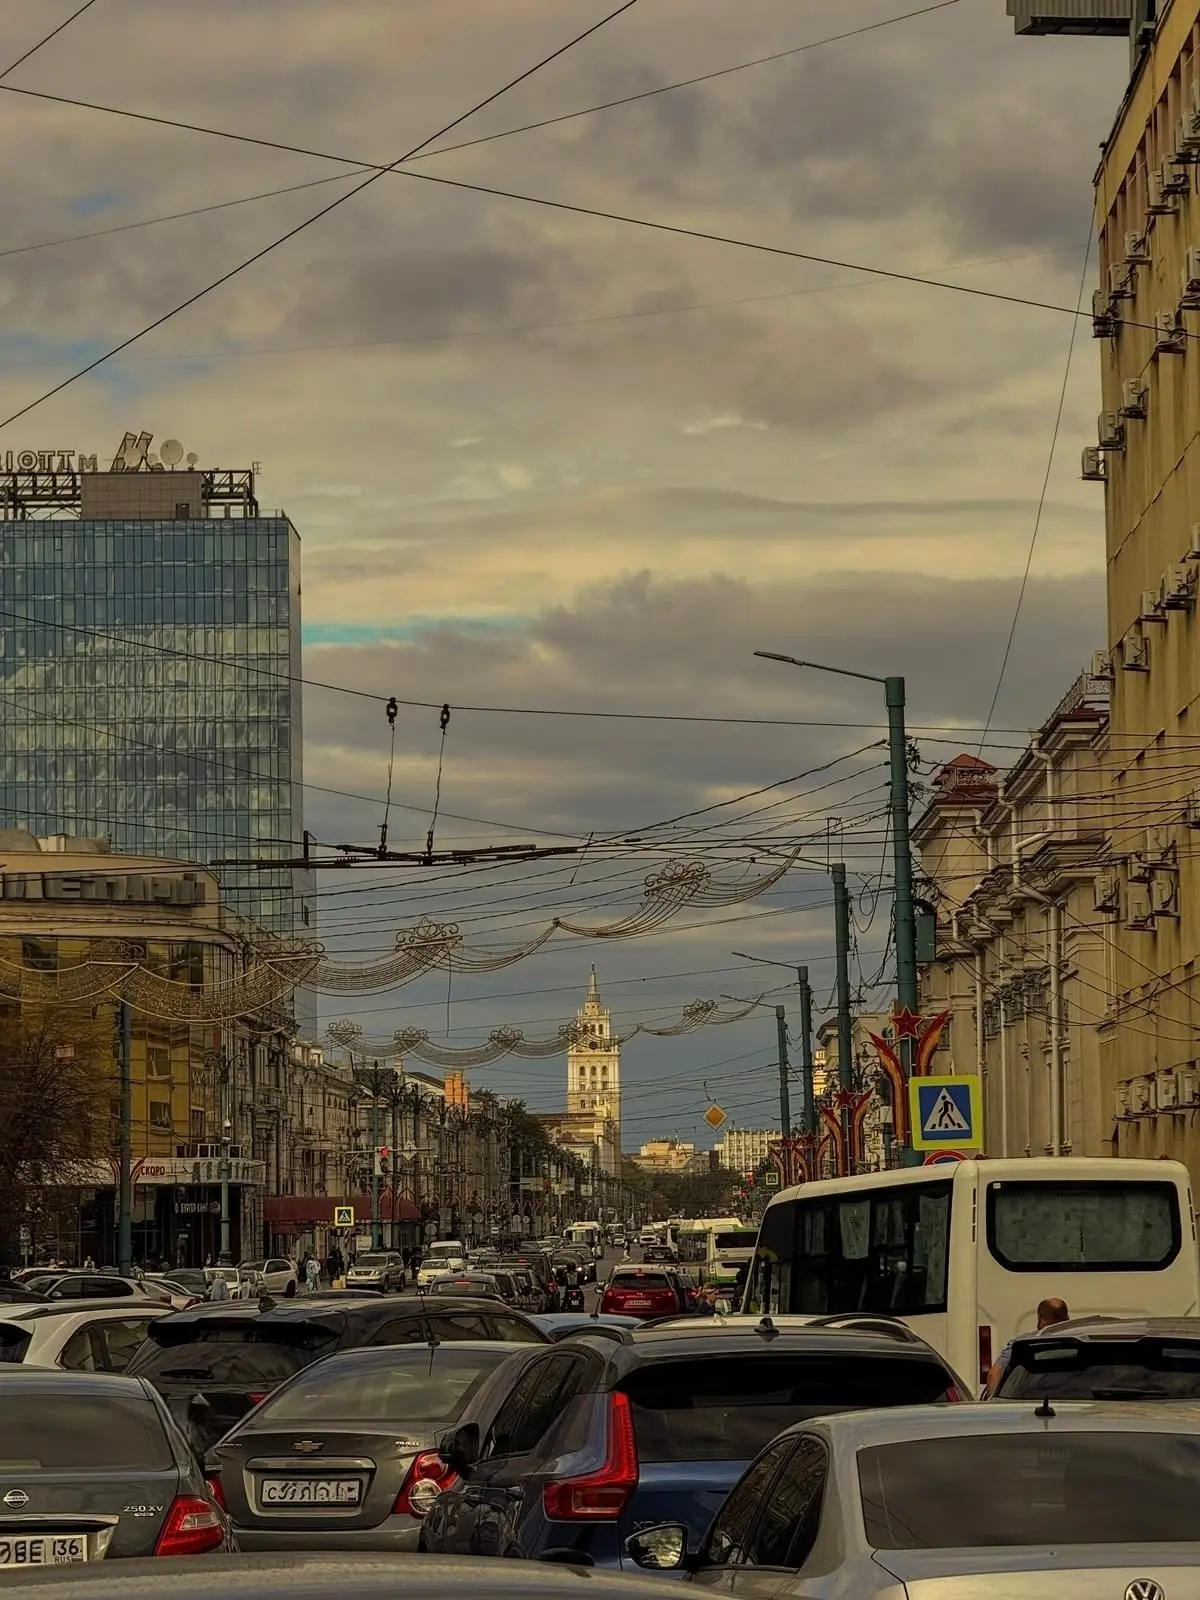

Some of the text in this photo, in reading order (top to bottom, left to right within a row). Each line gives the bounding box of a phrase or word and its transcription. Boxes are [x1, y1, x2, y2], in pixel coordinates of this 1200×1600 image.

[0, 449, 76, 472] IOTT
[140, 1165, 166, 1176] СКОРО
[123, 1504, 164, 1513] 250 XV
[52, 1538, 80, 1556] 136
